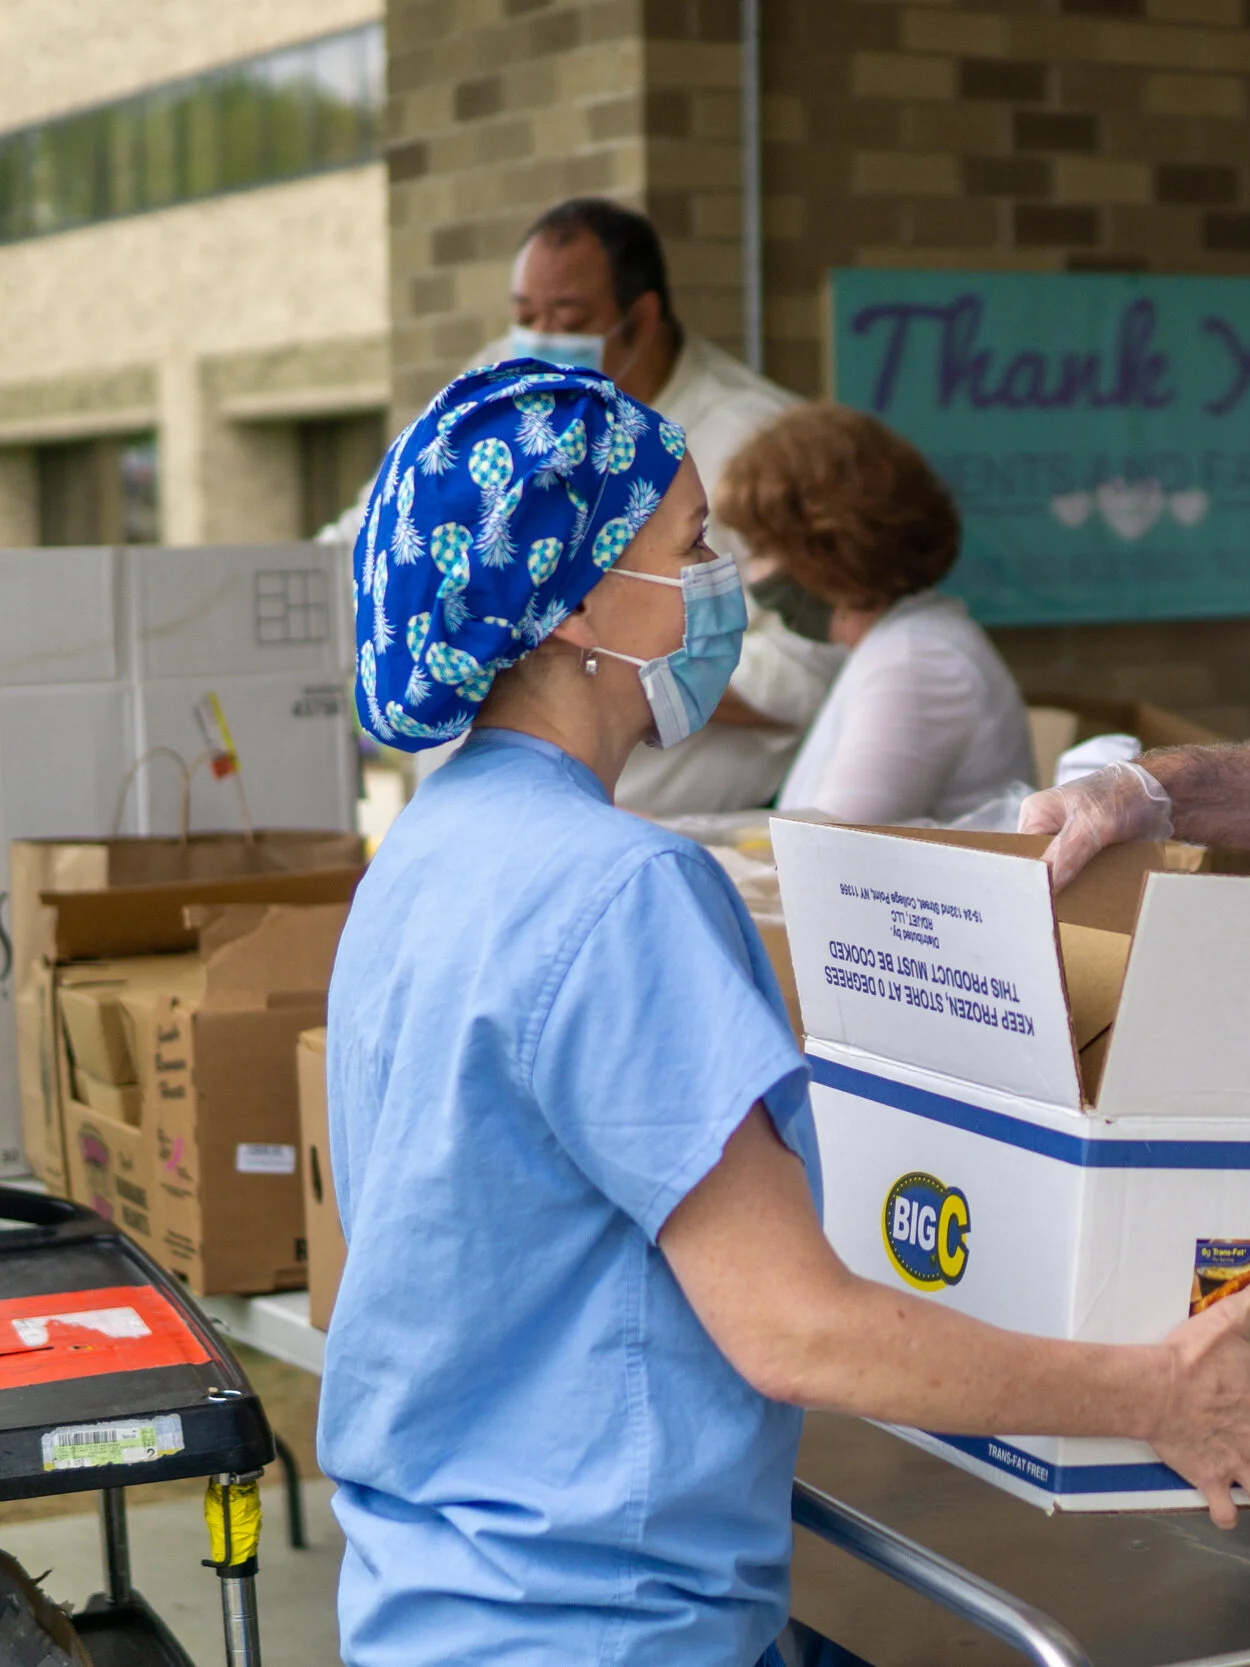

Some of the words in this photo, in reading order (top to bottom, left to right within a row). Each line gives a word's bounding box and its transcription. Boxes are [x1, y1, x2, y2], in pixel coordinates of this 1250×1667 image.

[851, 293, 1175, 413] Thank
[860, 886, 870, 900] NY
[891, 891, 917, 909] College
[891, 910, 906, 924] LLC
[940, 903, 962, 919] 132nd
[902, 928, 940, 949] Distributed
[829, 940, 876, 966] COOKED
[878, 951, 894, 972] BE
[824, 965, 877, 995] DEGREES
[897, 954, 928, 981] MUST
[931, 963, 989, 996] PRODUCT
[879, 978, 886, 996] 0
[889, 981, 902, 1002] AT
[904, 984, 944, 1014] STORE
[992, 977, 1020, 1003] THIS
[946, 993, 998, 1027] FROZEN,
[1001, 1011, 1035, 1036] KEEP
[893, 1195, 937, 1252] BIG
[988, 1443, 1027, 1473] TRANS-FAT
[1027, 1461, 1049, 1482] FREE!
